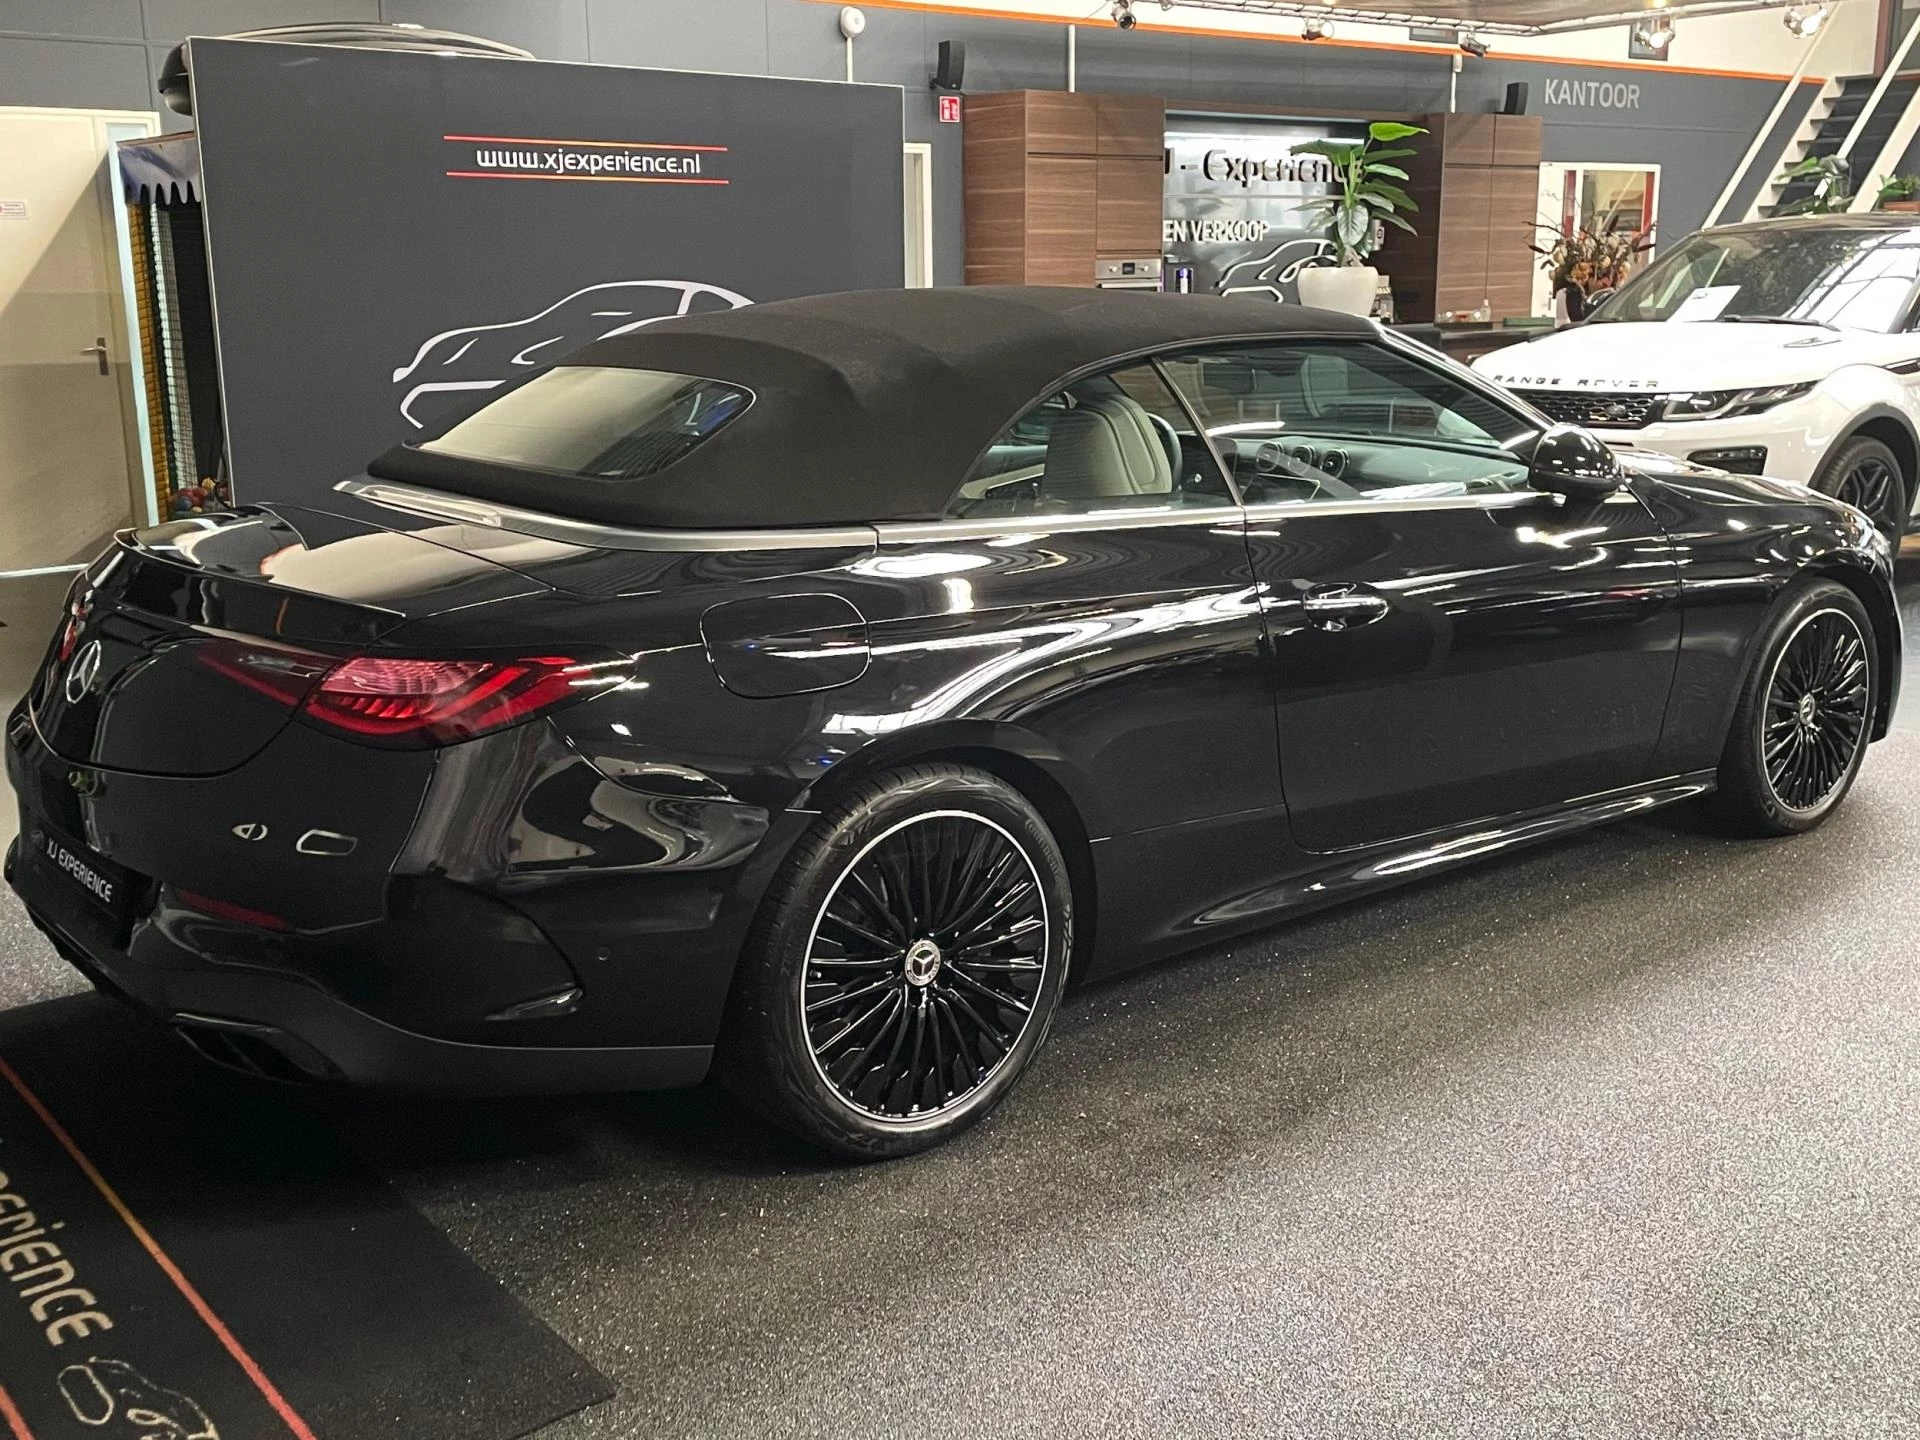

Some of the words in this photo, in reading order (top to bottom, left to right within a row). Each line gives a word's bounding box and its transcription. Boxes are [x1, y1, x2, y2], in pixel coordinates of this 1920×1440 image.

[1544, 78, 1640, 109] KANTOOR
[476, 148, 701, 174] www.xjexperience.nl
[1162, 219, 1187, 242] EN
[1190, 219, 1270, 244] VERKOOP
[1493, 374, 1561, 386] RANGE
[1577, 378, 1659, 389] ROVER
[46, 837, 59, 860] XJ
[58, 847, 113, 903] EXPERIENCE
